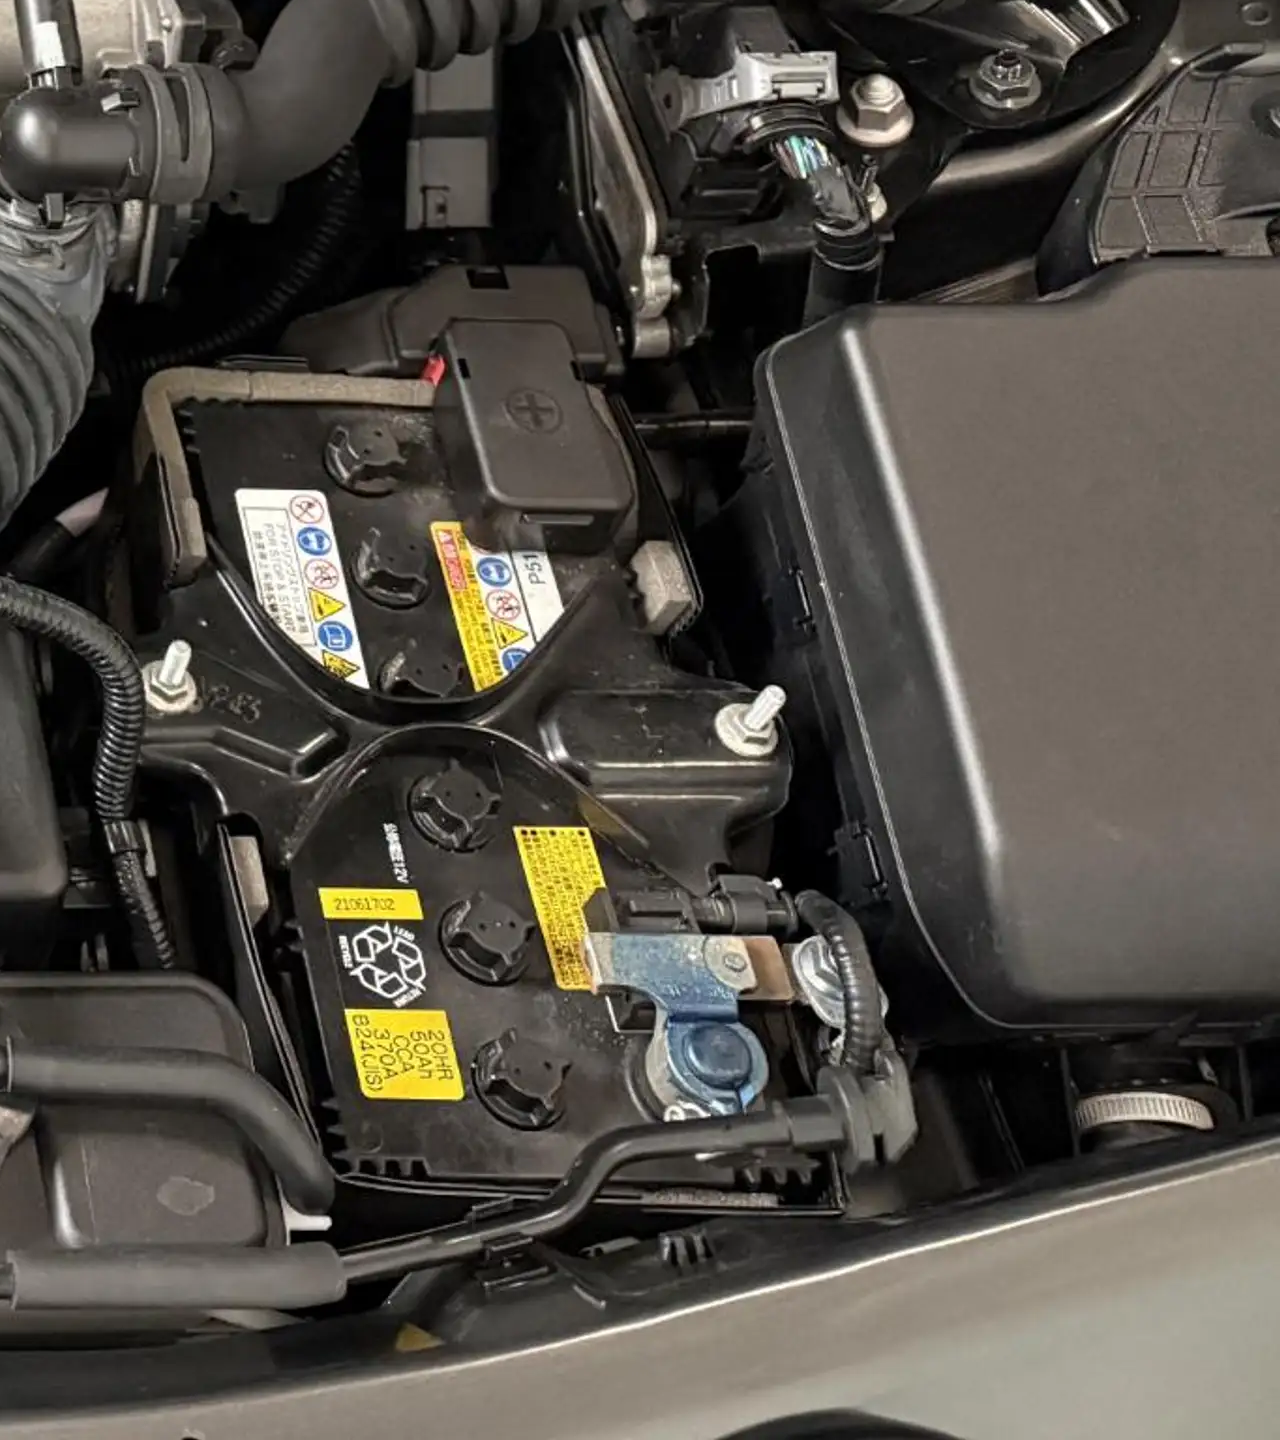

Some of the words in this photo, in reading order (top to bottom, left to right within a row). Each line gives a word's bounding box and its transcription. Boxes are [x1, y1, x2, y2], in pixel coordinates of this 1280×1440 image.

[521, 554, 546, 585] P51
[352, 1014, 384, 1093] B24(JIS)
[372, 1028, 399, 1081] 370A
[391, 1035, 416, 1074] CCA
[430, 1030, 454, 1081] 20HR
